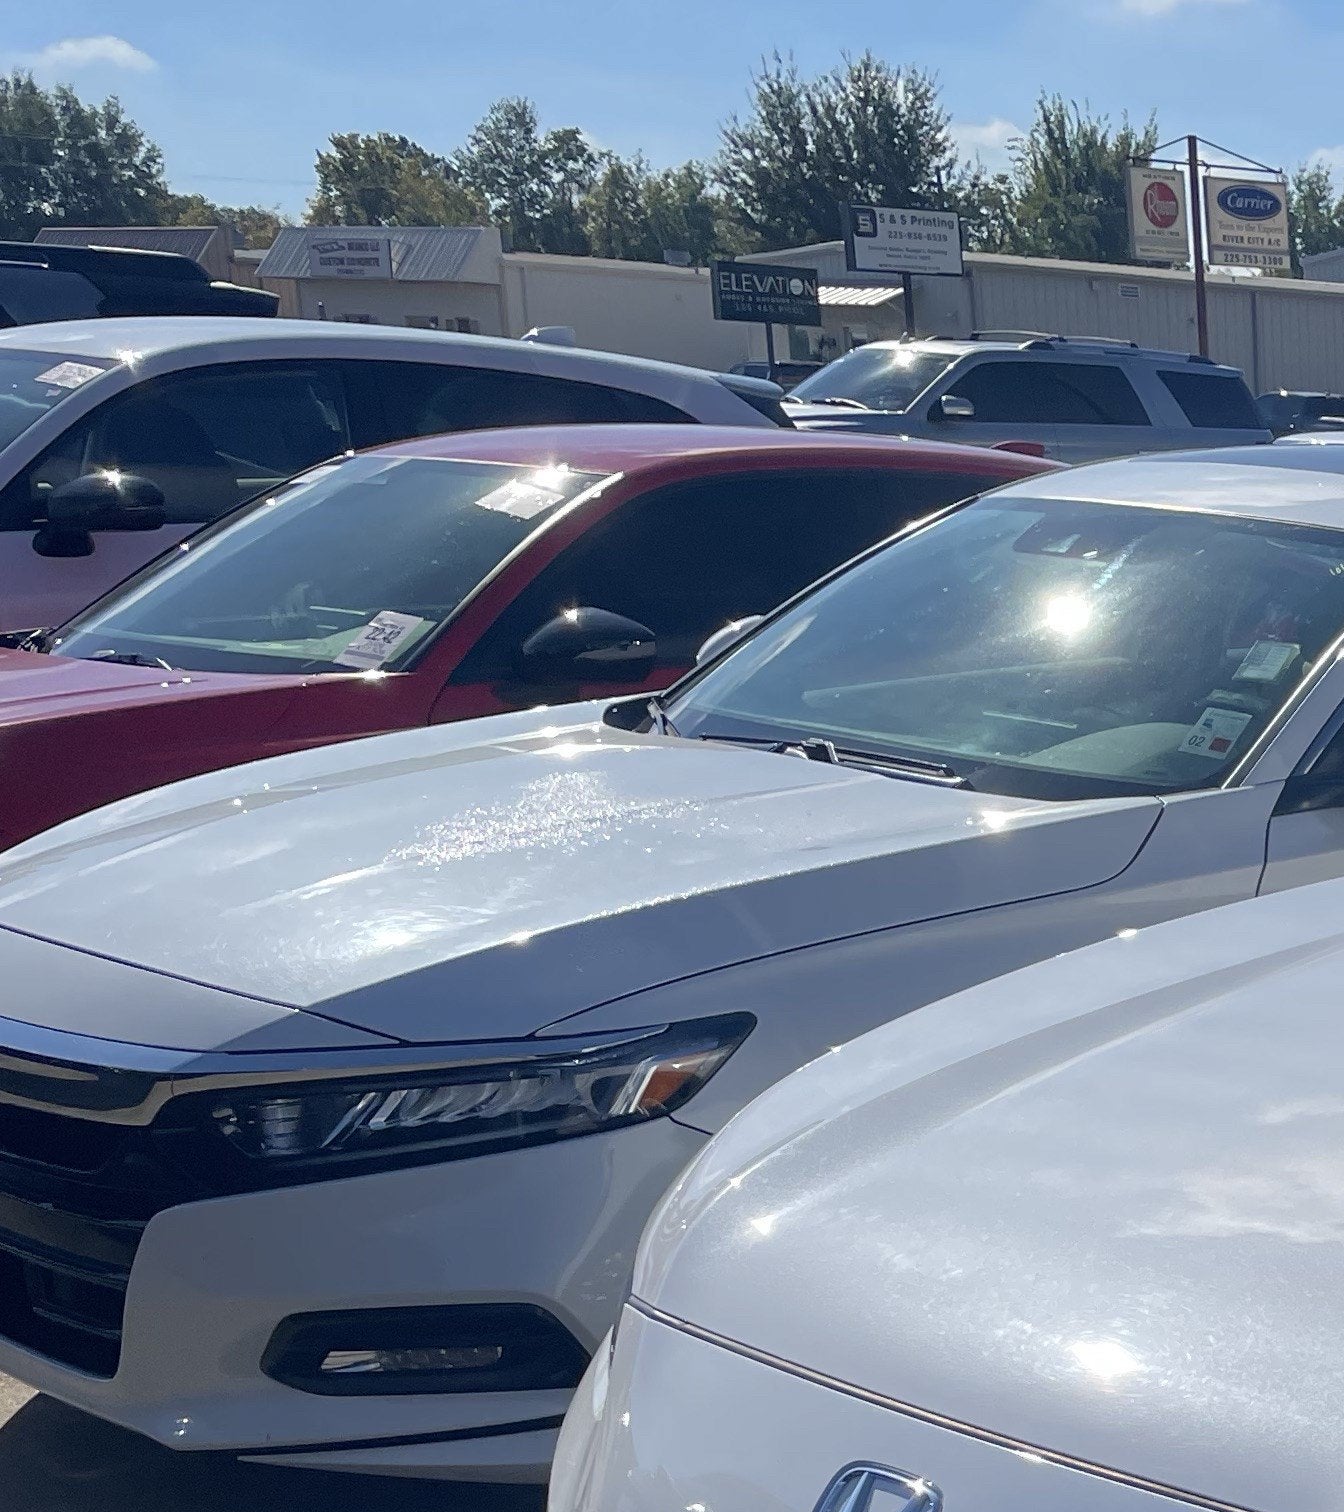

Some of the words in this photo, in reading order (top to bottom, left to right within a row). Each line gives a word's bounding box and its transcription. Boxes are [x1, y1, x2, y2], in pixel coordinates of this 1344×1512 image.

[1226, 192, 1274, 210] Carrier
[879, 213, 885, 223] S
[889, 214, 896, 224] &
[900, 214, 907, 225] S
[910, 215, 955, 230] Printing
[1247, 236, 1265, 246] CITY
[720, 271, 817, 297] ELEVATION
[1187, 735, 1206, 748] 02
